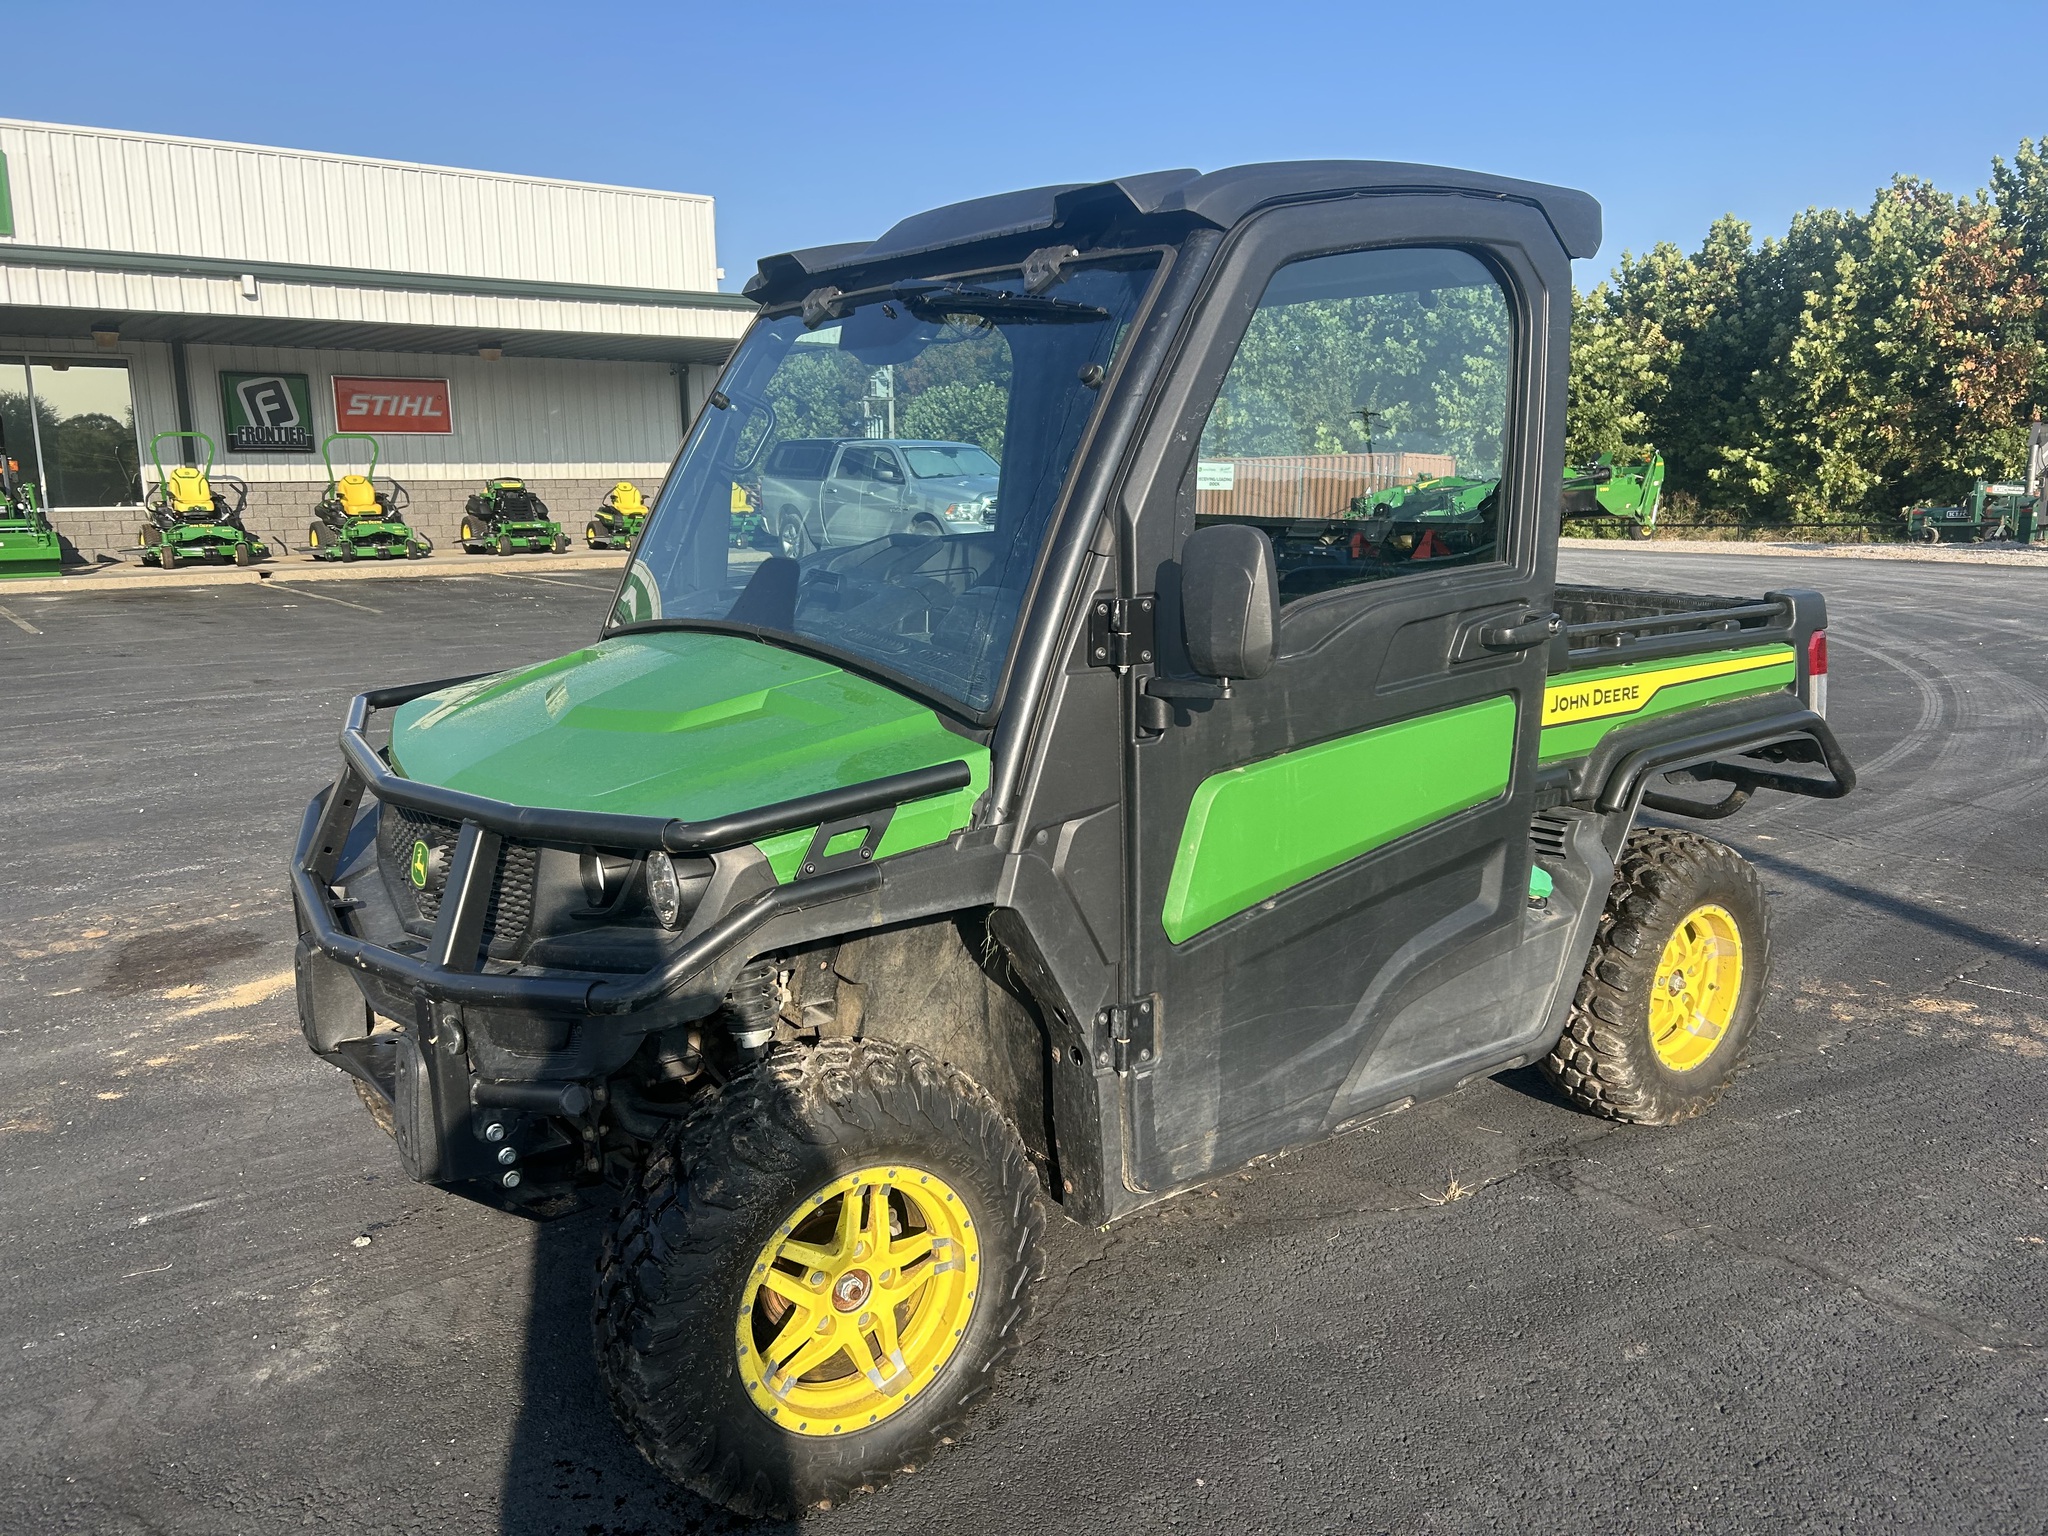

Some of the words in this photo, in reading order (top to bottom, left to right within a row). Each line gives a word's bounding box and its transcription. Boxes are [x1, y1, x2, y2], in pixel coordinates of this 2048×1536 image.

[346, 394, 442, 416] STIHL
[238, 426, 306, 442] FRONTIER
[1550, 693, 1590, 713] JOHN
[1593, 685, 1639, 706] DEERE
